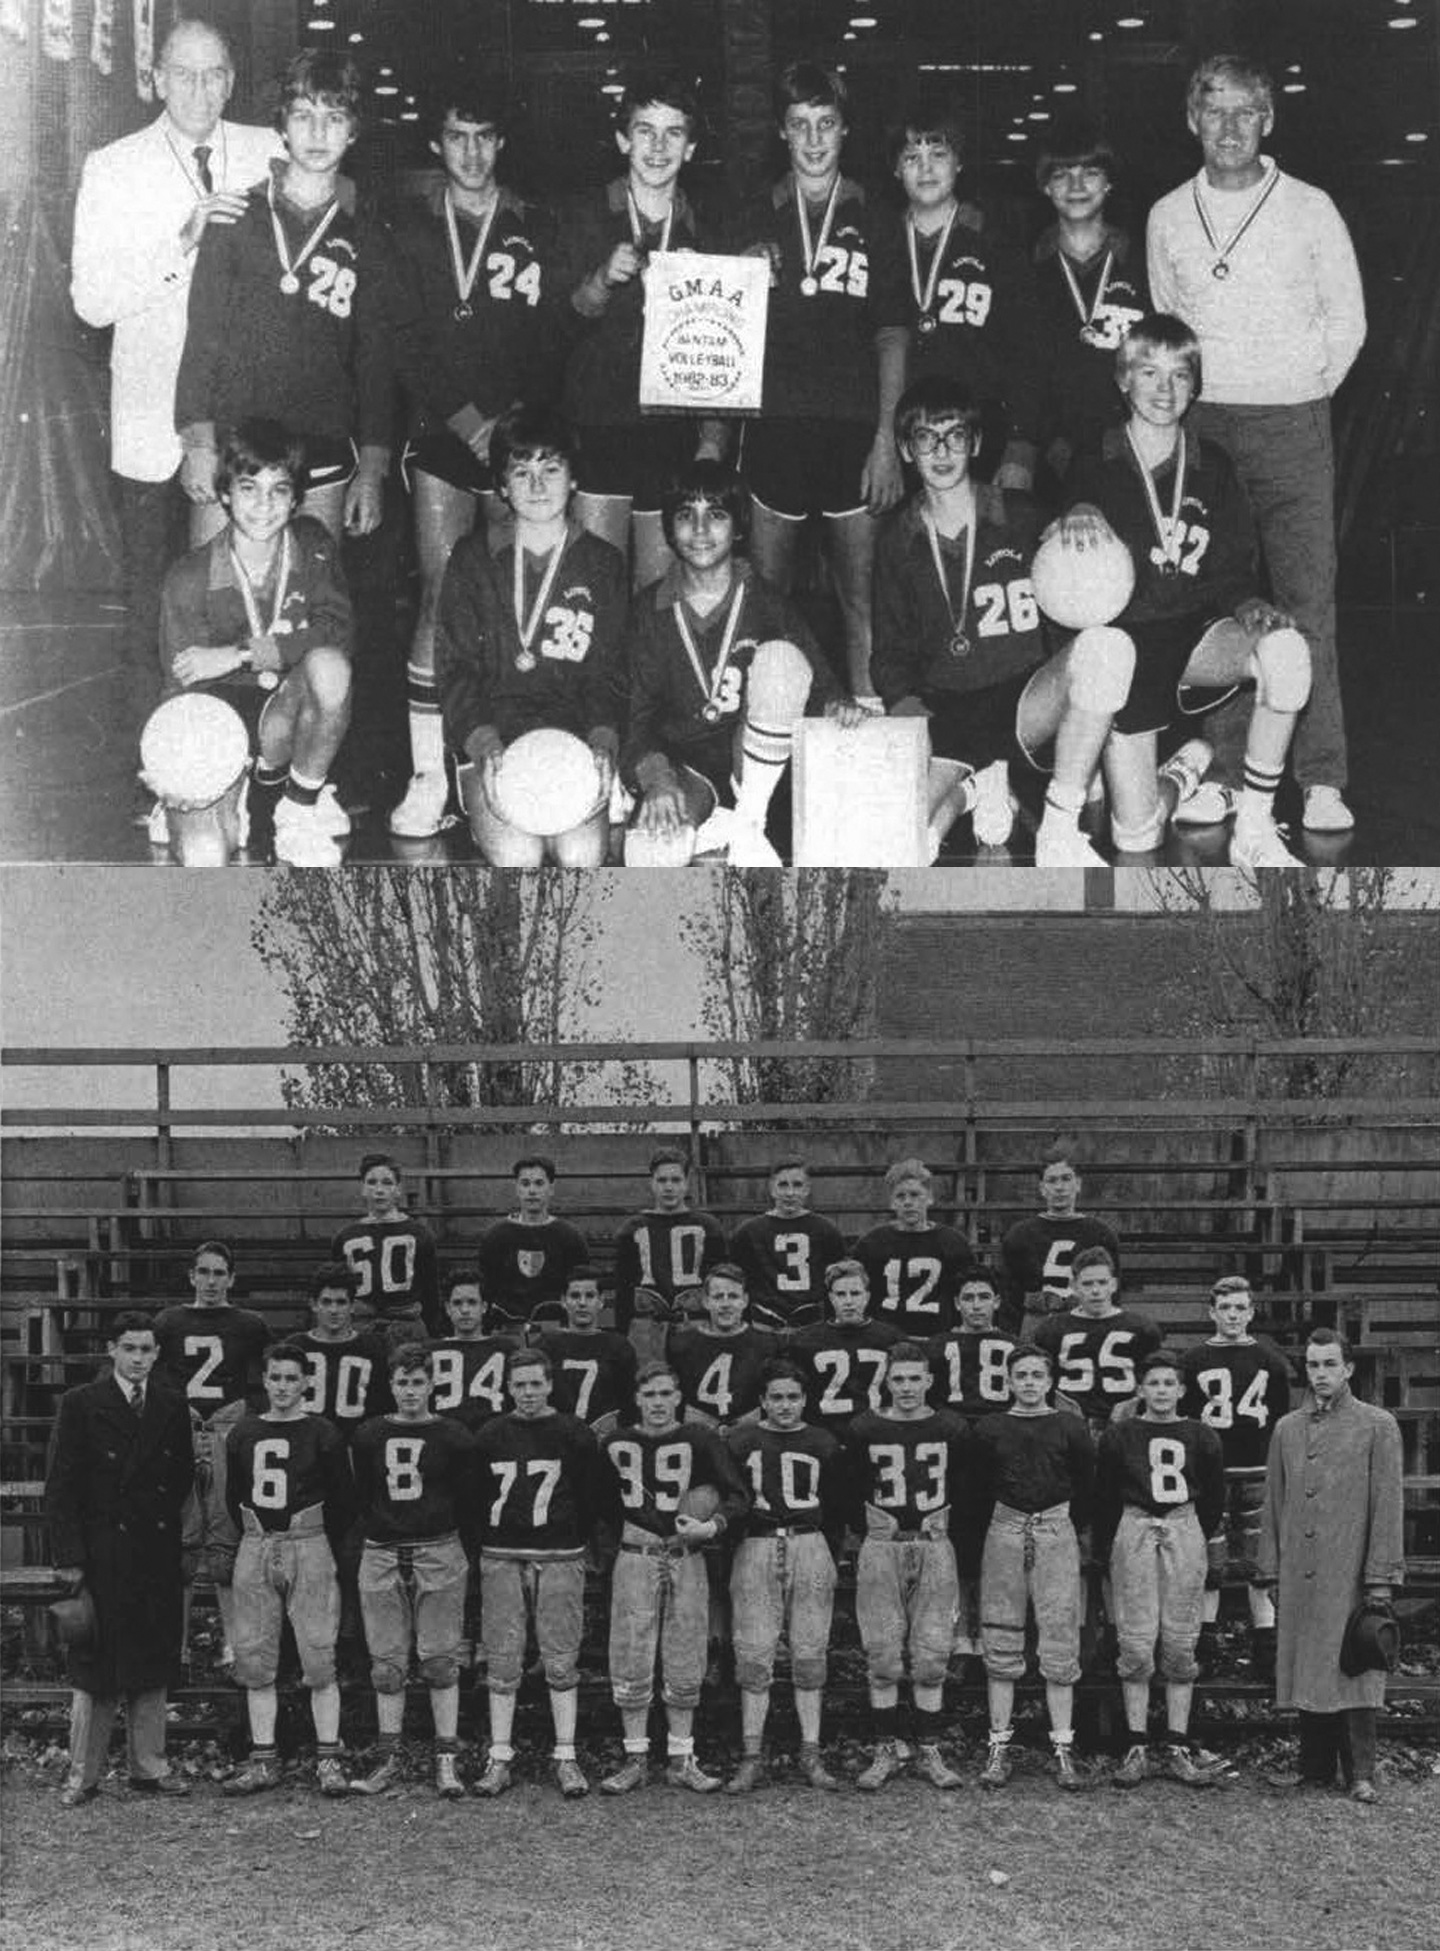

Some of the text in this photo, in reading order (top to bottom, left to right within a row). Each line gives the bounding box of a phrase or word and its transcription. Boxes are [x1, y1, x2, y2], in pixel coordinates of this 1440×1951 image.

[308, 256, 356, 318] 28
[487, 253, 540, 306] 24
[818, 245, 869, 297] 25
[938, 279, 992, 327] 29
[668, 351, 736, 368] VOLLEYBALL
[541, 606, 594, 662] 36
[974, 578, 1039, 637] 26
[635, 1226, 706, 1286] 10
[775, 1233, 811, 1290] 3
[882, 1257, 942, 1313] 12
[184, 1336, 224, 1398] 2
[432, 1350, 505, 1412] 94
[563, 1359, 599, 1418] 7
[698, 1353, 733, 1415] 4
[814, 1349, 888, 1414] 27
[944, 1339, 1014, 1402] 18
[1058, 1331, 1136, 1393] 55
[1197, 1368, 1269, 1428] 84
[252, 1439, 290, 1509] 6
[386, 1438, 426, 1500] 8
[490, 1460, 562, 1526] 77
[608, 1441, 692, 1511] 99
[747, 1451, 820, 1510] 10
[869, 1442, 948, 1511] 33
[1149, 1438, 1189, 1503] 8
